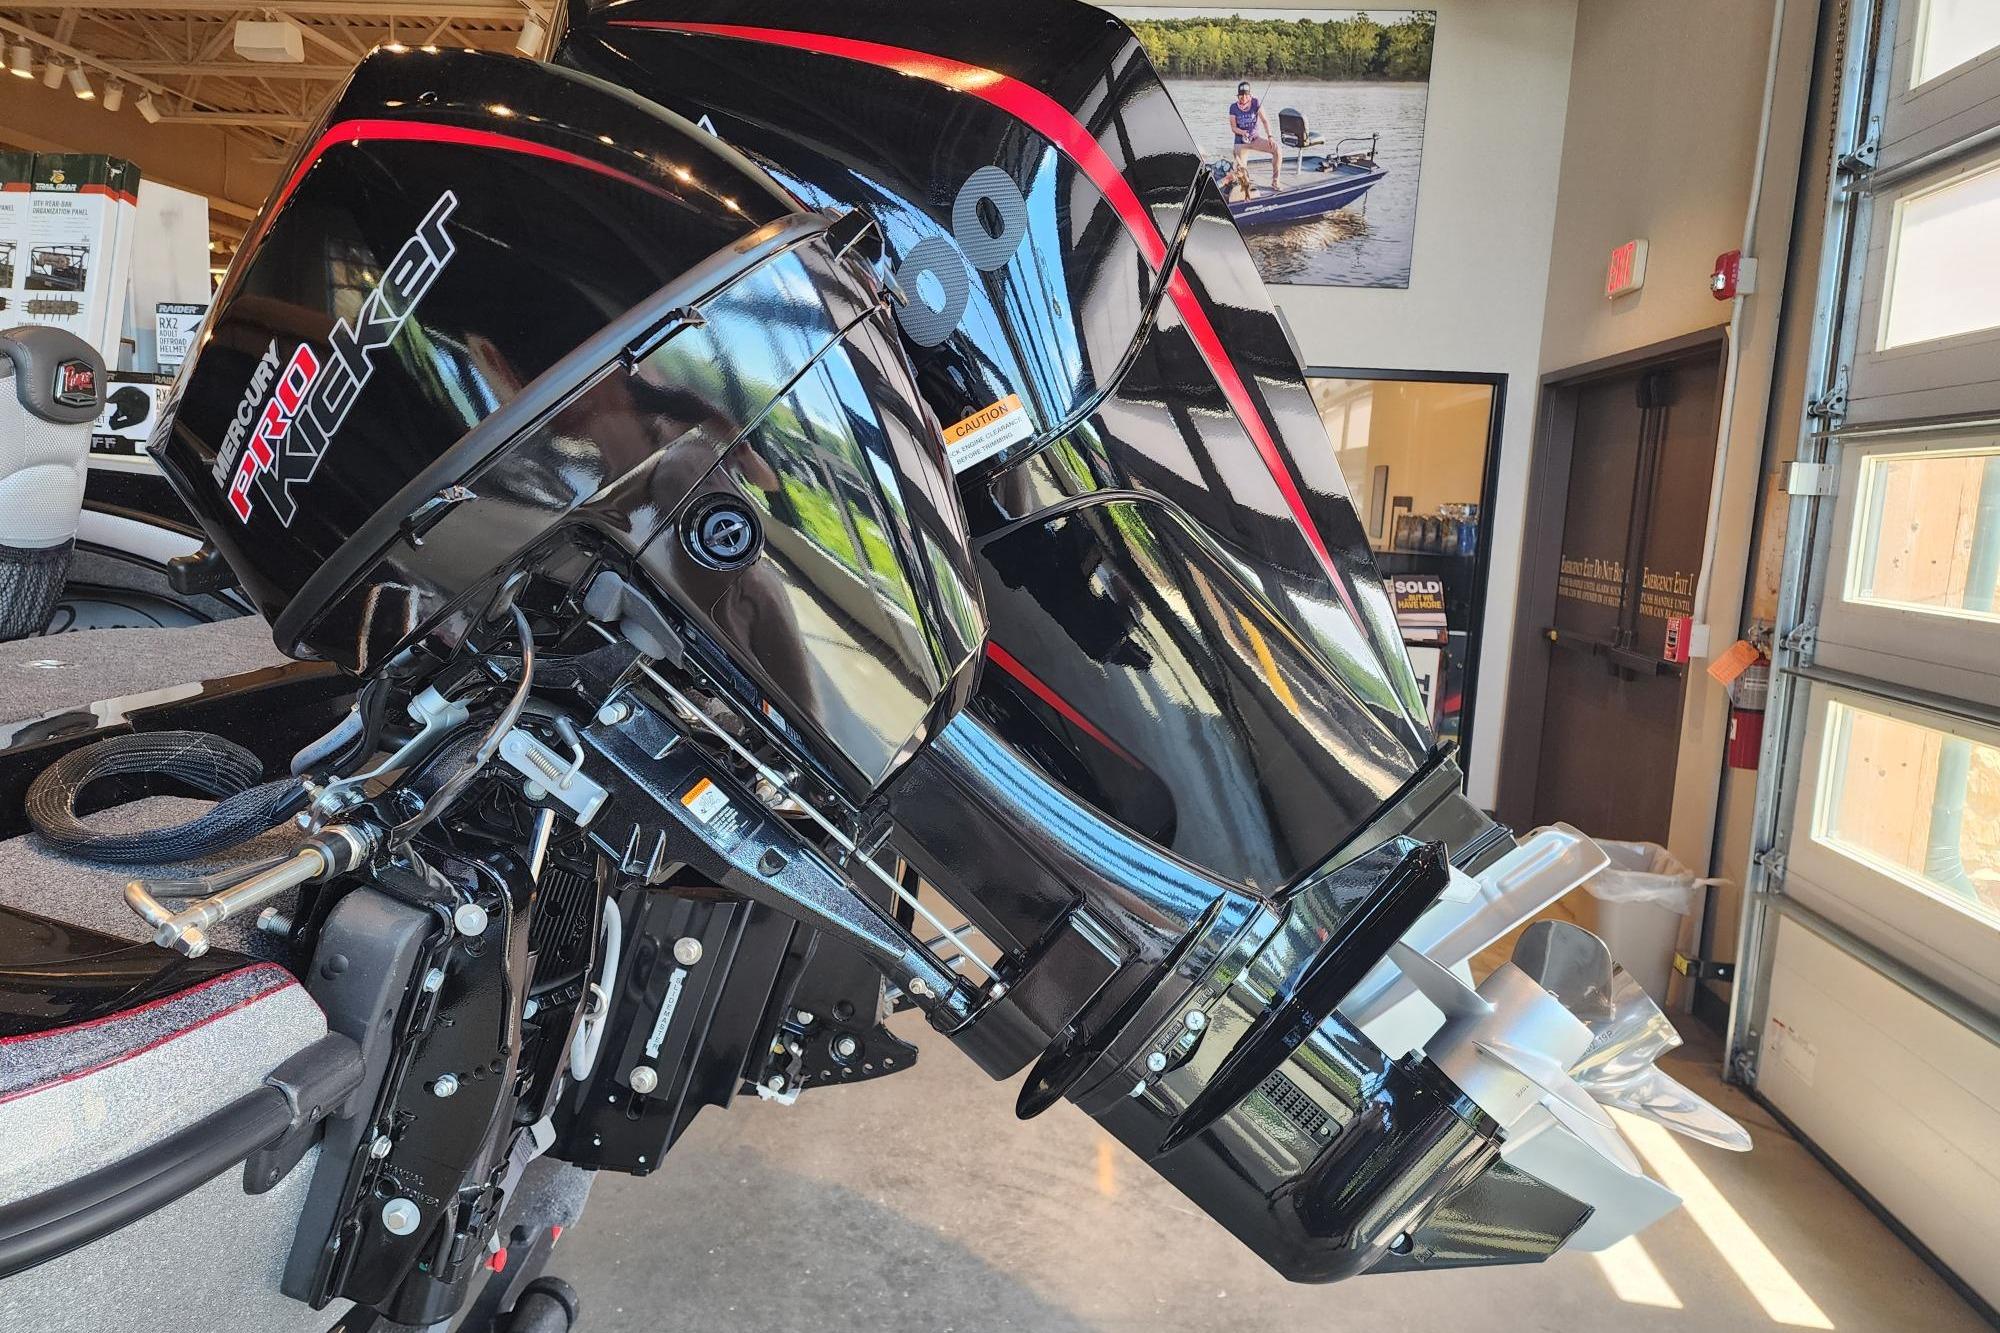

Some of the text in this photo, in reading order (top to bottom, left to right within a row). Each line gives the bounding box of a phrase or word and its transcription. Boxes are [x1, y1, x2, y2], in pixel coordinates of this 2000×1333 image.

[56, 183, 77, 191] GEAR
[71, 208, 88, 216] PANEL
[158, 304, 197, 314] RAIDER
[159, 317, 179, 329] RX2
[159, 329, 179, 338] ADULT
[159, 337, 188, 346] OFFROAD
[211, 339, 280, 488] MERCURY
[956, 404, 1008, 437] CAUTION
[228, 343, 319, 524] PRO
[956, 431, 1013, 465] BEFORE TRIMMING
[961, 437, 984, 452] ENGINE
[1395, 581, 1440, 594] SOLD
[1398, 600, 1419, 609] HAVE
